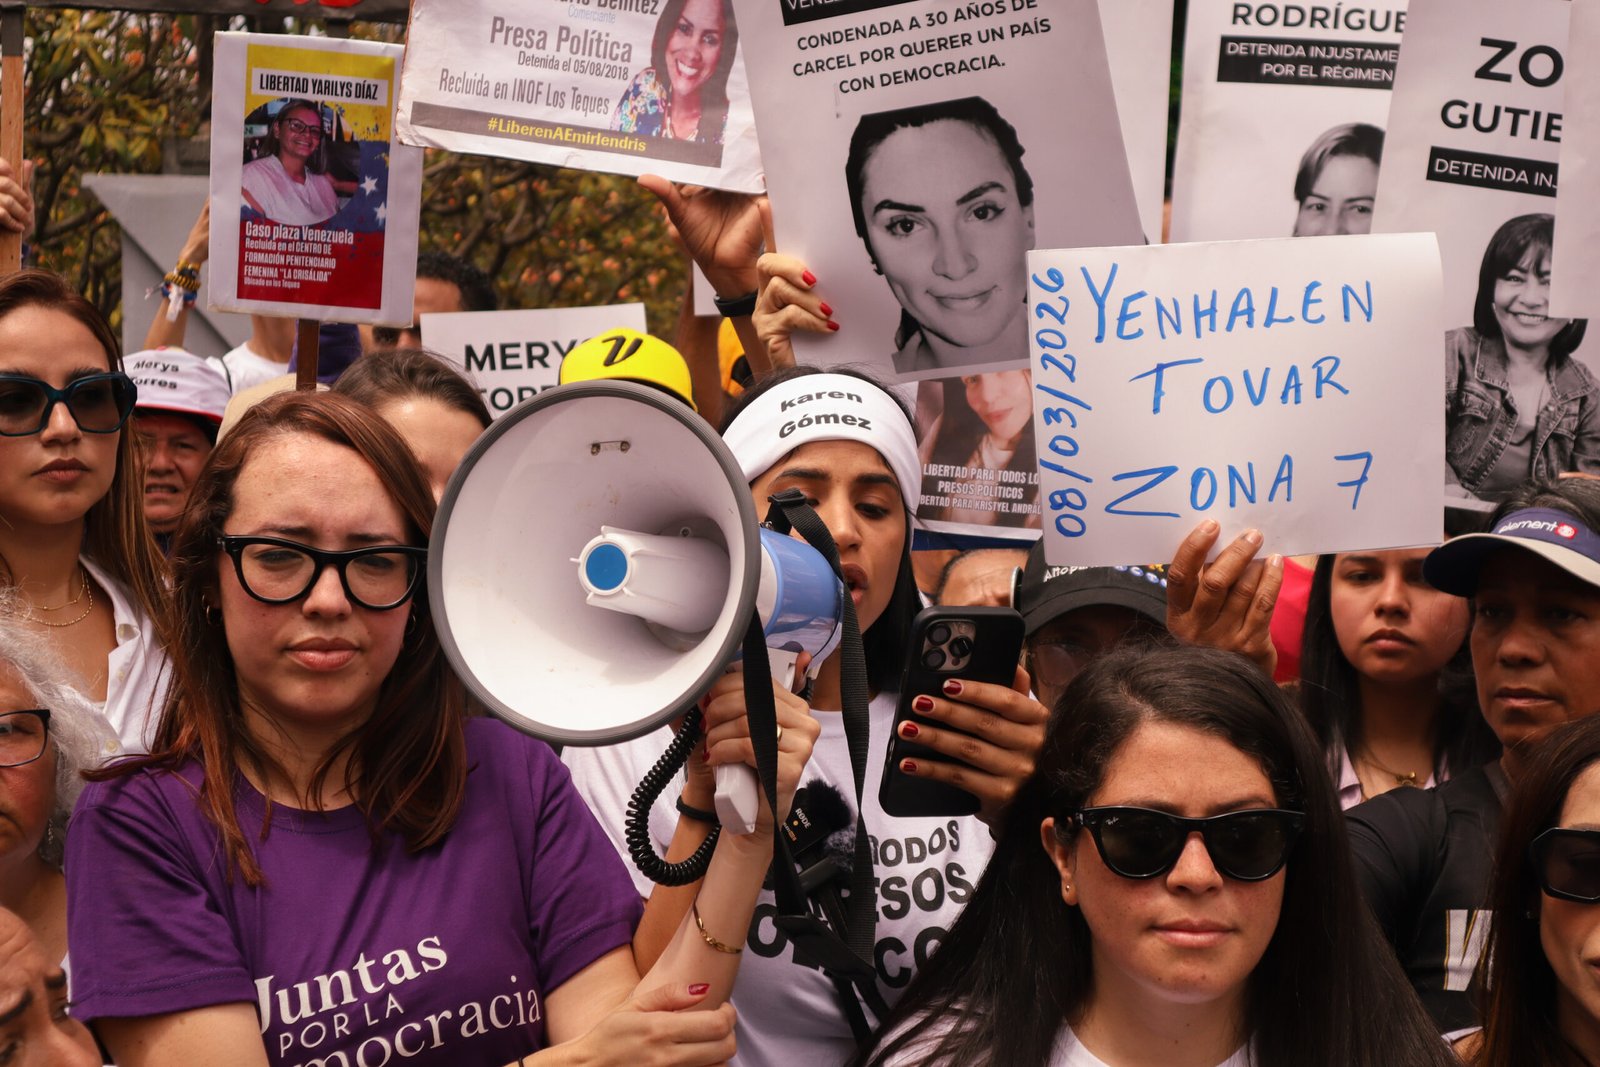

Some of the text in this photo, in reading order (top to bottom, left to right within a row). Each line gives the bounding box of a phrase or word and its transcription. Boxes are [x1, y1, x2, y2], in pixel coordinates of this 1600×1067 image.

[568, 4, 616, 24] Comerciante
[796, 0, 1038, 50] CONDENADA A 30 AÑOS DE
[490, 16, 633, 62] Presa Política
[792, 17, 1052, 77] CARCEL POR QUERER UN PAÍS
[1226, 42, 1399, 62] DETENIDA INJUSTAME
[518, 51, 629, 80] Detenida el 05/08/2018
[839, 54, 1006, 94] CON DEMOCRACIA.
[1262, 64, 1296, 76] POR
[1298, 64, 1318, 78] EL
[1474, 37, 1565, 88] ZO
[260, 73, 378, 100] LIBERTAD YARILYS DÍAZ
[438, 68, 610, 118] Recluida en INOF Los Teques
[488, 117, 647, 152] #LiberenAEmirlendris
[1440, 100, 1563, 143] GUTIE
[1434, 158, 1558, 189] DETENIDA IN
[246, 221, 354, 244] Caso plaza Venezuela
[246, 238, 332, 255] Recluida en el CENTRO DE
[244, 252, 336, 270] FORMACIÓN PENITENCIARIO
[244, 266, 278, 278] FEMENINA
[1081, 262, 1373, 343] YENHALEN
[134, 360, 180, 372] Merys
[464, 339, 591, 371] MERY
[1128, 356, 1350, 414] TOVAR
[780, 391, 863, 412] karen
[1032, 267, 1094, 538] 08/03/2026
[779, 414, 872, 438] Gómez
[923, 464, 968, 478] LIBERTAD
[970, 468, 994, 480] PARA
[998, 470, 1026, 484] TODOS
[1105, 452, 1373, 518] ZONA 7
[938, 480, 1024, 500] PRESOS POLÍTICOS
[952, 498, 974, 509] PARA
[974, 500, 1010, 512] KRISTYEL
[1498, 520, 1558, 534] element
[254, 936, 448, 1034] Juntas
[280, 993, 404, 1058] POR LA
